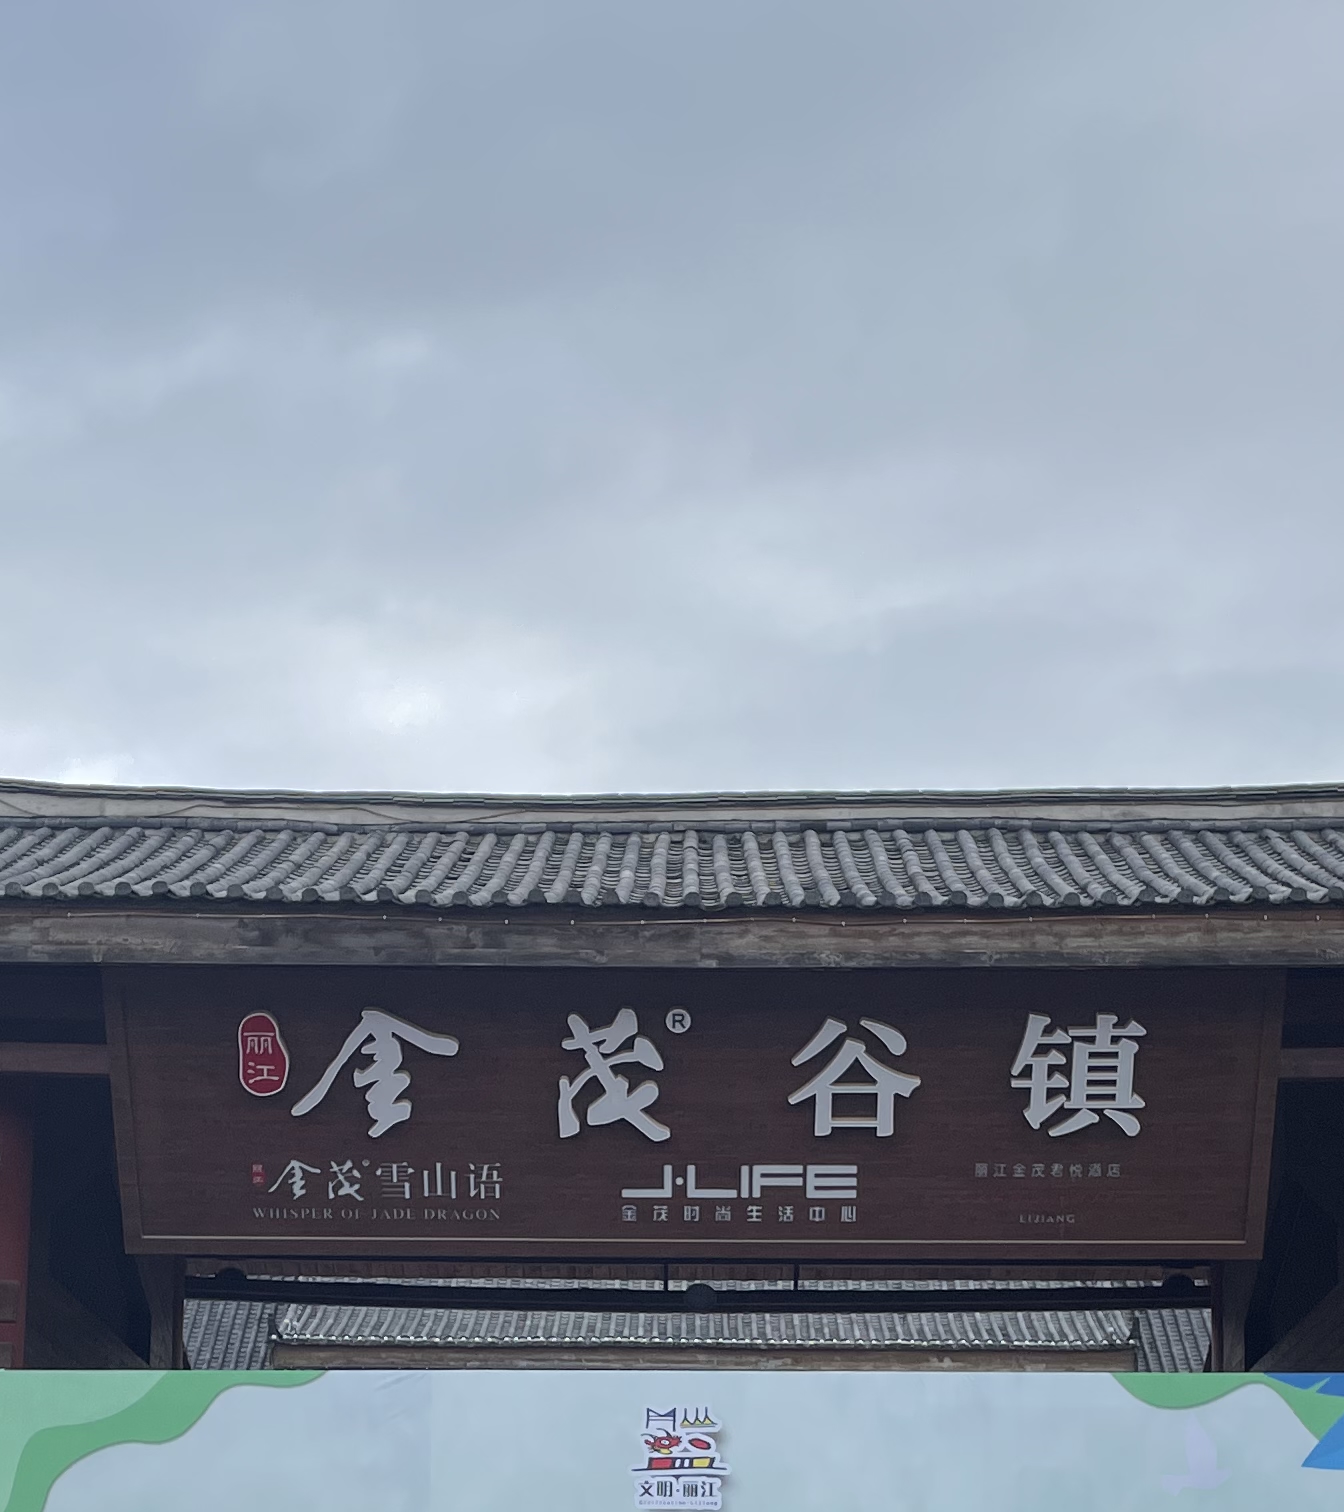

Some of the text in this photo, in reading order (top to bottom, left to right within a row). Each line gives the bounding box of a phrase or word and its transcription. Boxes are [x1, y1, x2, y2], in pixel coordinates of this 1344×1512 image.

[291, 1008, 1146, 1141] 金茂谷镇
[974, 1163, 1121, 1179] 丽江金茂君悦酒店
[252, 1207, 333, 1220] WHISPER
[371, 1207, 416, 1220] JADE
[424, 1207, 501, 1221] DRAGON
[621, 1205, 857, 1222] 金茂时尚生活中心
[1019, 1213, 1075, 1224] LIJIANG
